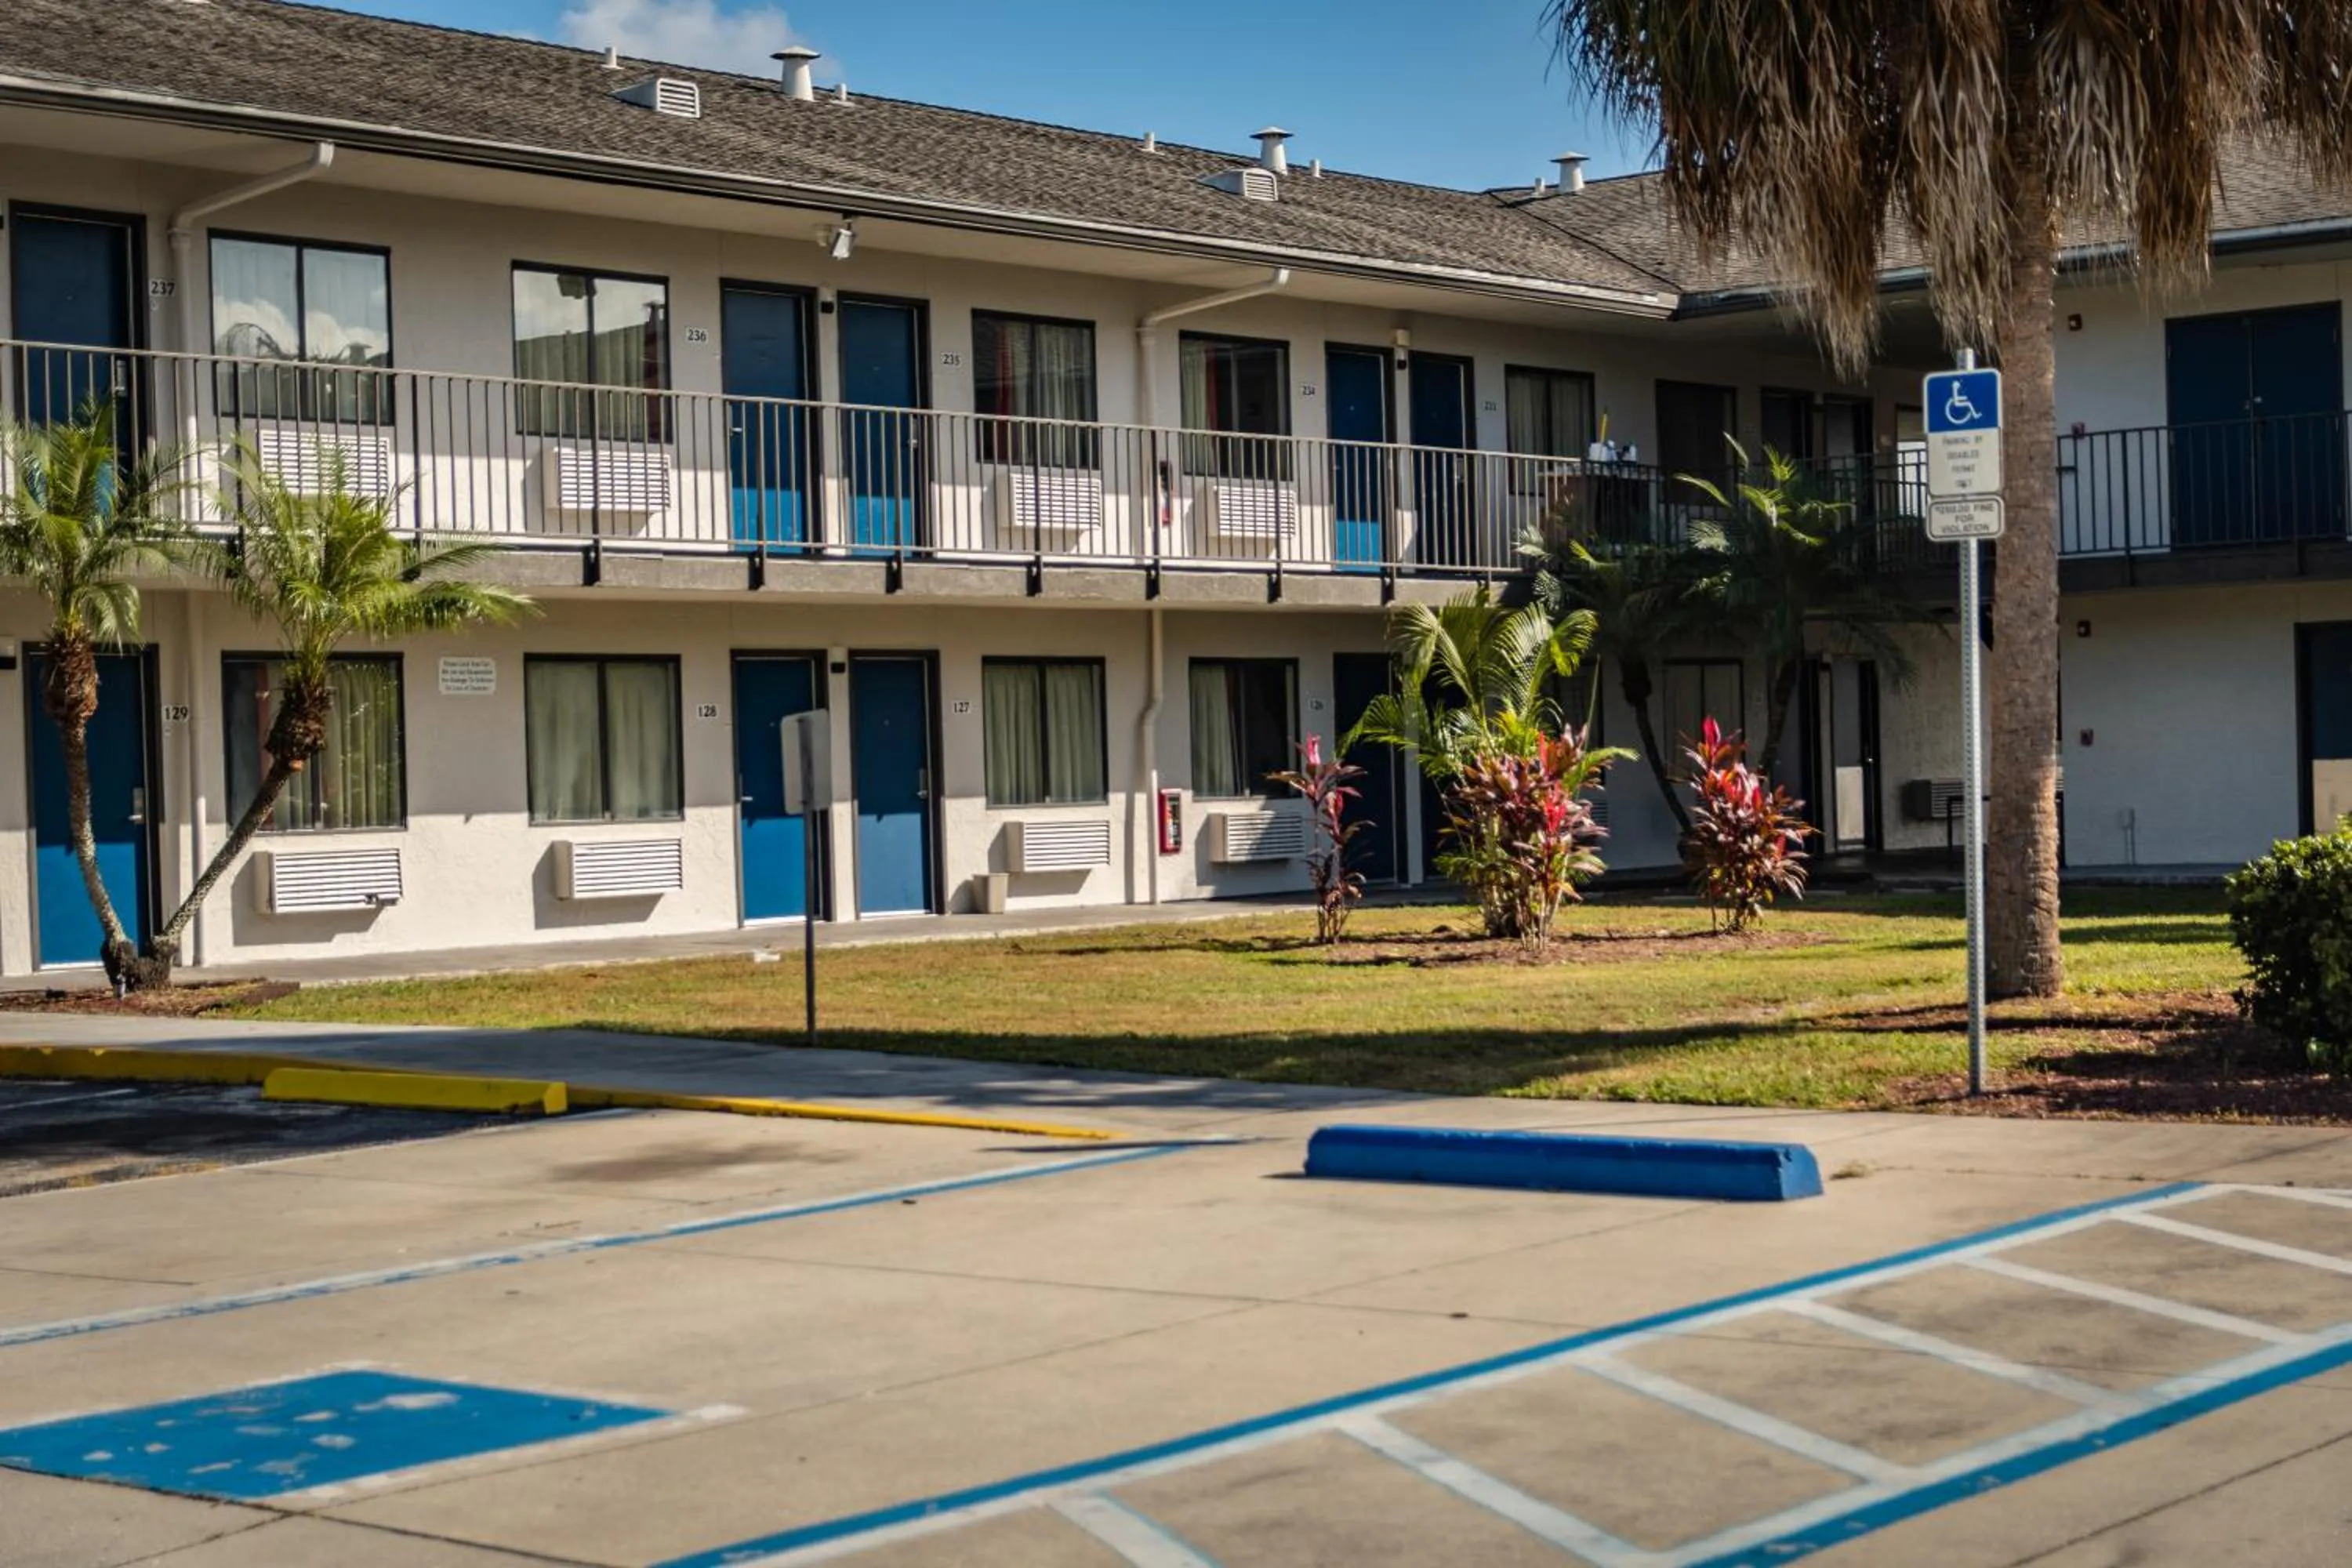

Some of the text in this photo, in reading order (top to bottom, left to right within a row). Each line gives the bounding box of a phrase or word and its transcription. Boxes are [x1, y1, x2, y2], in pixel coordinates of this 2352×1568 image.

[151, 281, 175, 296] 237
[688, 328, 706, 342] 236
[165, 706, 188, 720] 129
[698, 705, 717, 717] 128
[954, 702, 970, 713] 127
